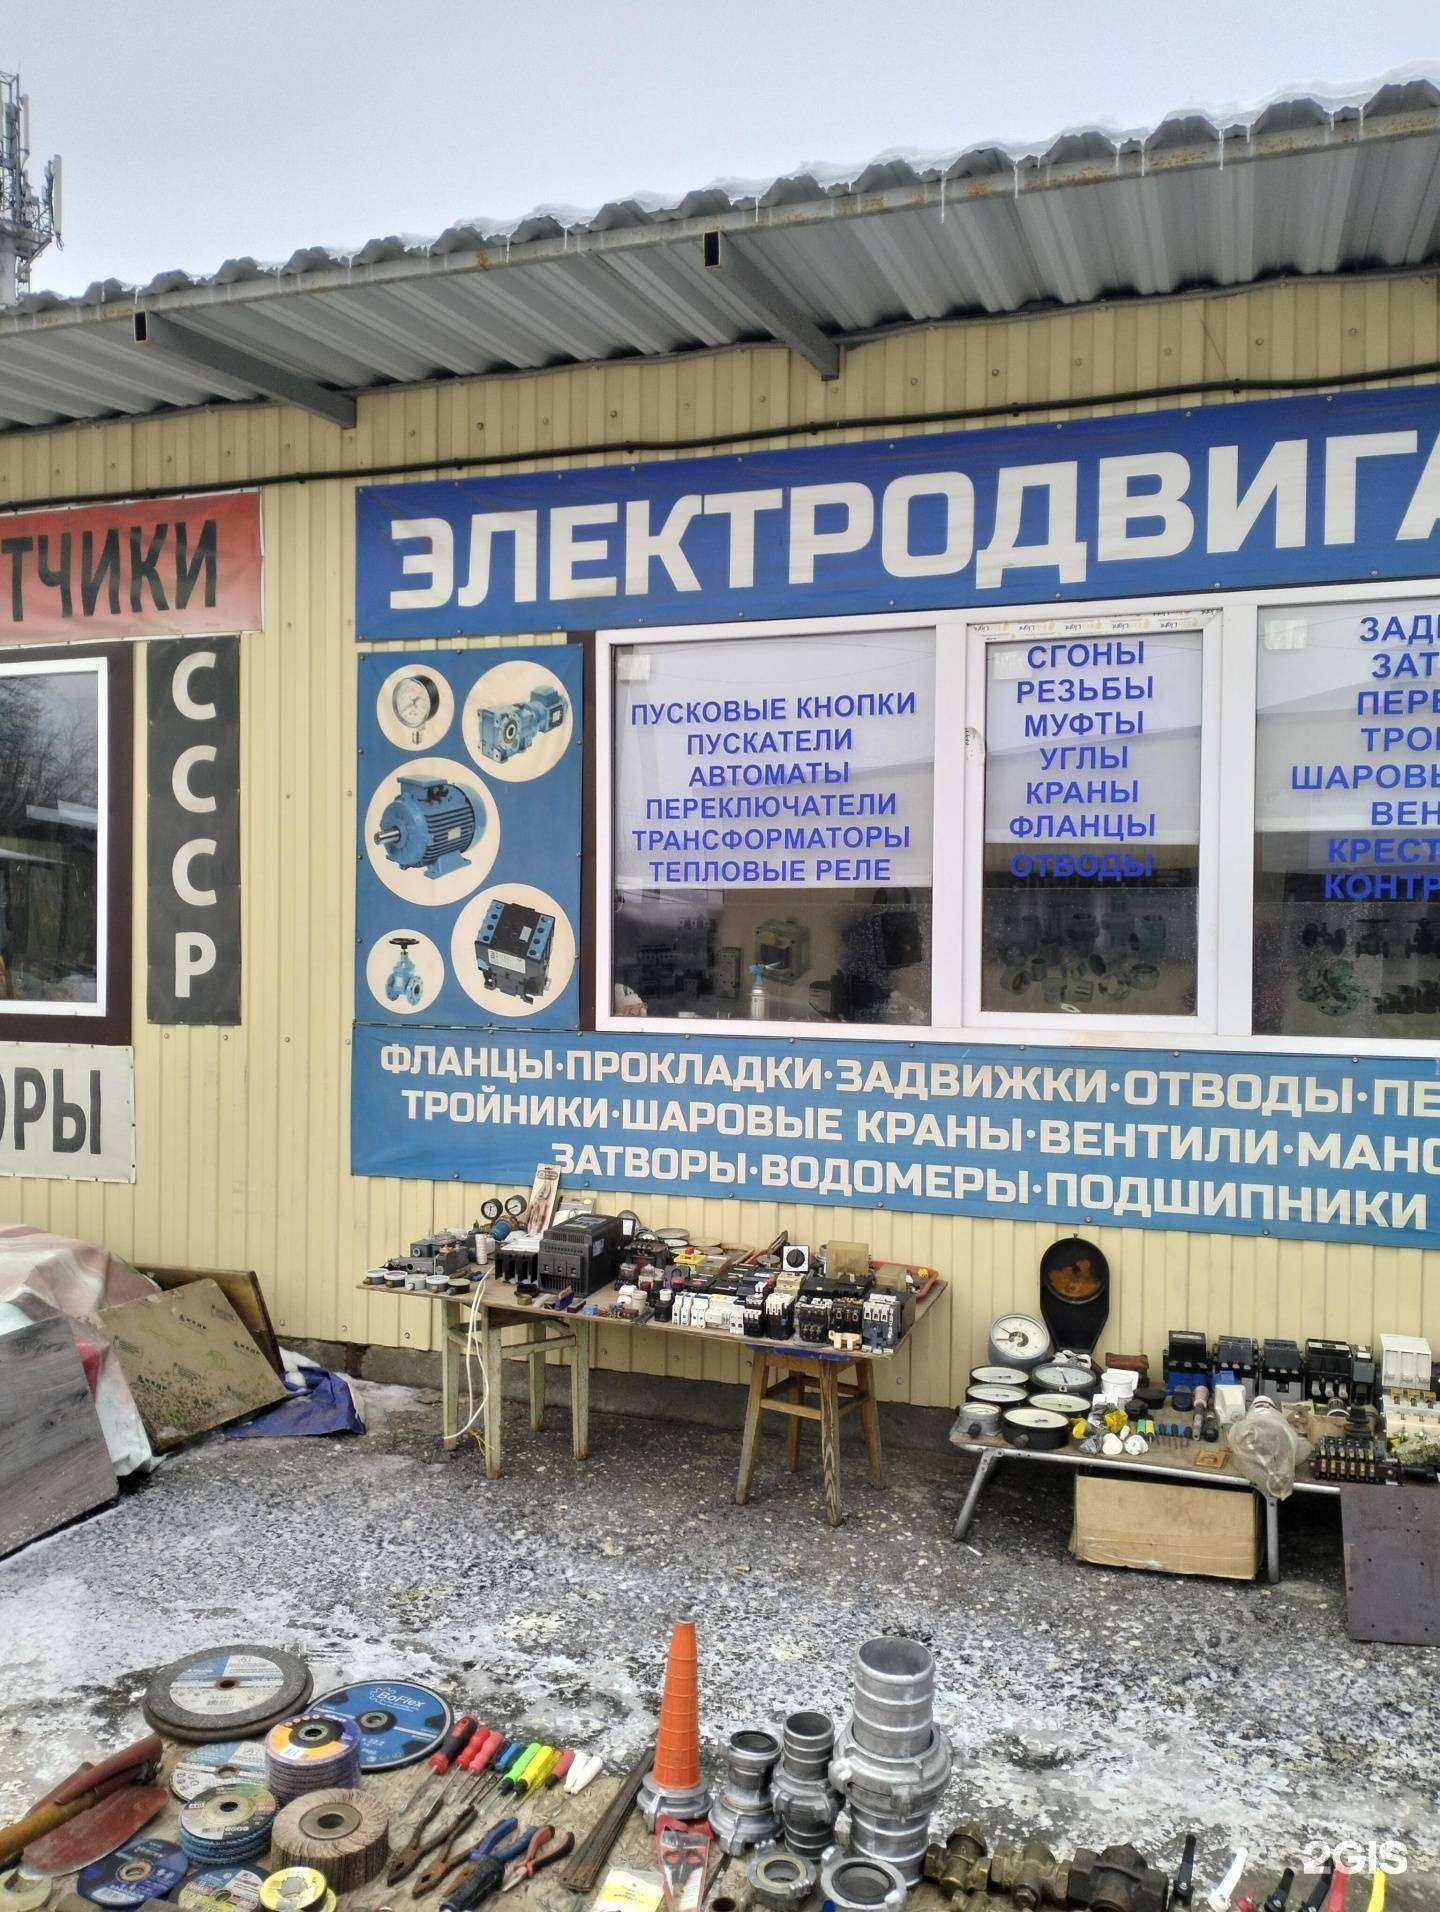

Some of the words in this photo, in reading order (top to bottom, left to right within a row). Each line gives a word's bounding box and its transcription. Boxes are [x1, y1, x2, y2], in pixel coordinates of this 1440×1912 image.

[0, 518, 217, 623] ТЧИКИ
[1359, 614, 1440, 645] ЗАД
[1027, 640, 1145, 670] СГОНЫ
[1016, 674, 1155, 704] РЕЗЬБЫ
[630, 697, 787, 726] ПУСКОВЫЕ
[796, 691, 917, 720] КНОПКИ
[1024, 710, 1145, 738] МУФТЫ
[686, 728, 853, 756] ПУСКАТЕЛИ
[1360, 726, 1440, 753] ТРО
[1040, 745, 1129, 772] УГЛЫ
[688, 761, 850, 788] АВТОМАТЫ
[645, 792, 897, 820] ПЕРЕКЛЮЧАТЕЛИ
[1025, 779, 1139, 806] КРАНЫ
[171, 650, 218, 998] СССР
[1009, 813, 1156, 842] ФЛАНЦЫ
[632, 826, 912, 852] ТРАНСФОРМАТОРЫ
[649, 859, 806, 883] ТЕПЛОВЫЕ
[815, 858, 892, 882] РЕЛЕ
[1009, 852, 1154, 882] ОТВОДЫ
[0, 1066, 103, 1156] РЫ
